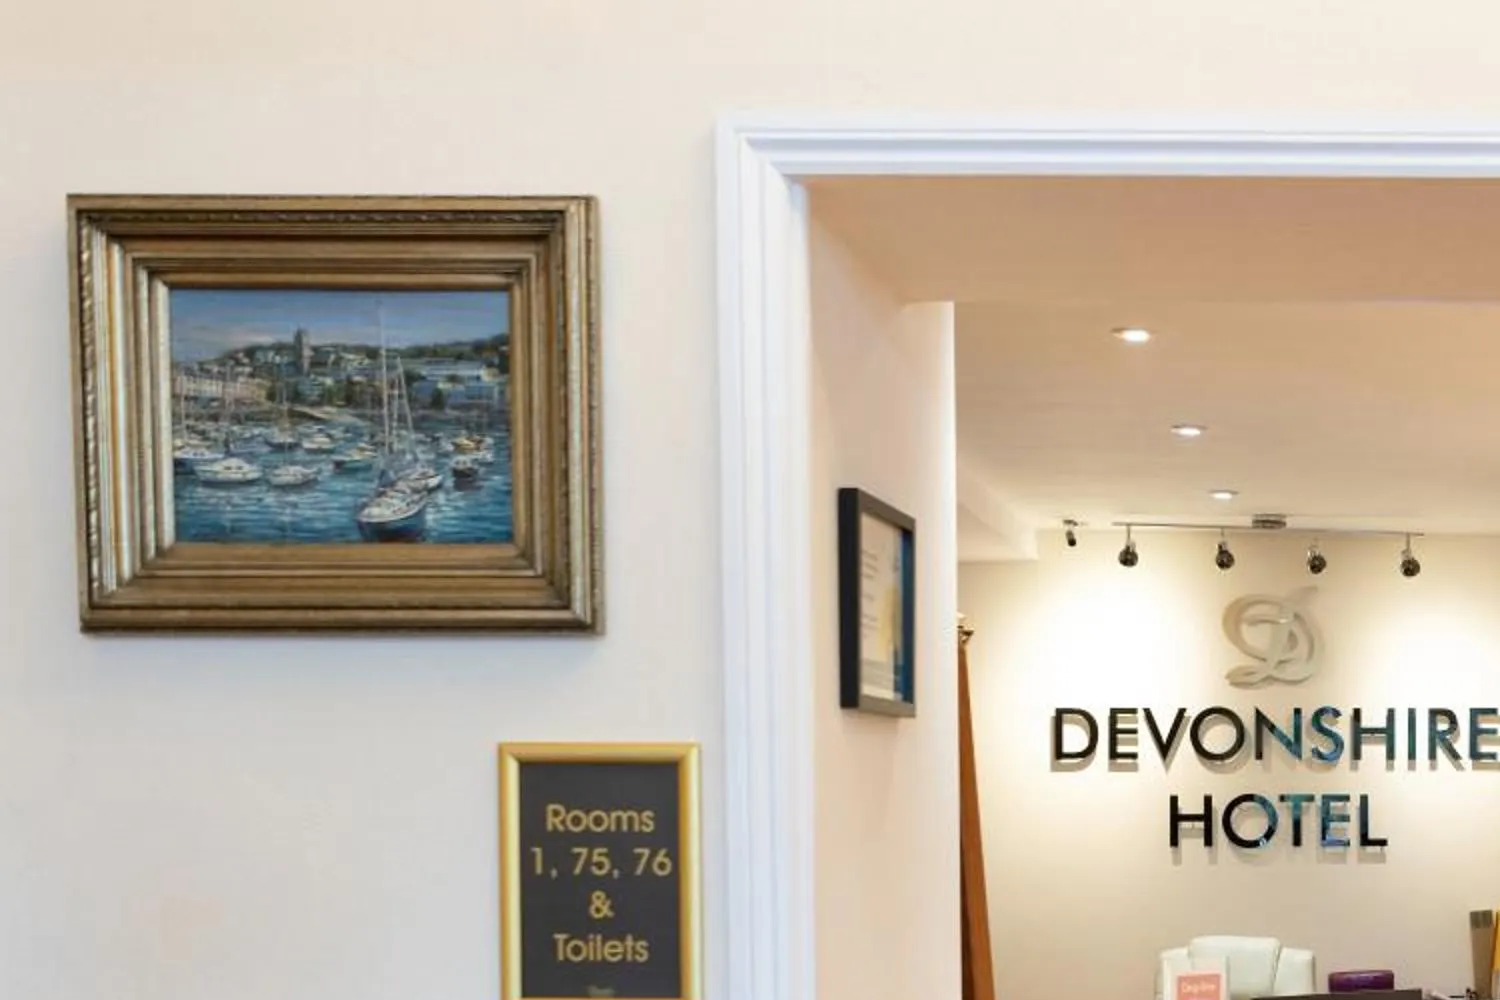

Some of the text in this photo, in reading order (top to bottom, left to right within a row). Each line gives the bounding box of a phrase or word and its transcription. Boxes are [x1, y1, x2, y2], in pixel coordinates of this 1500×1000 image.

[1054, 706, 1500, 767] DEVONSHIRE
[546, 804, 655, 832] Rooms
[1169, 794, 1389, 849] HOTEL
[571, 847, 620, 879] 75,
[633, 848, 672, 876] 76
[588, 890, 615, 919] &
[554, 933, 650, 963] Toilets
